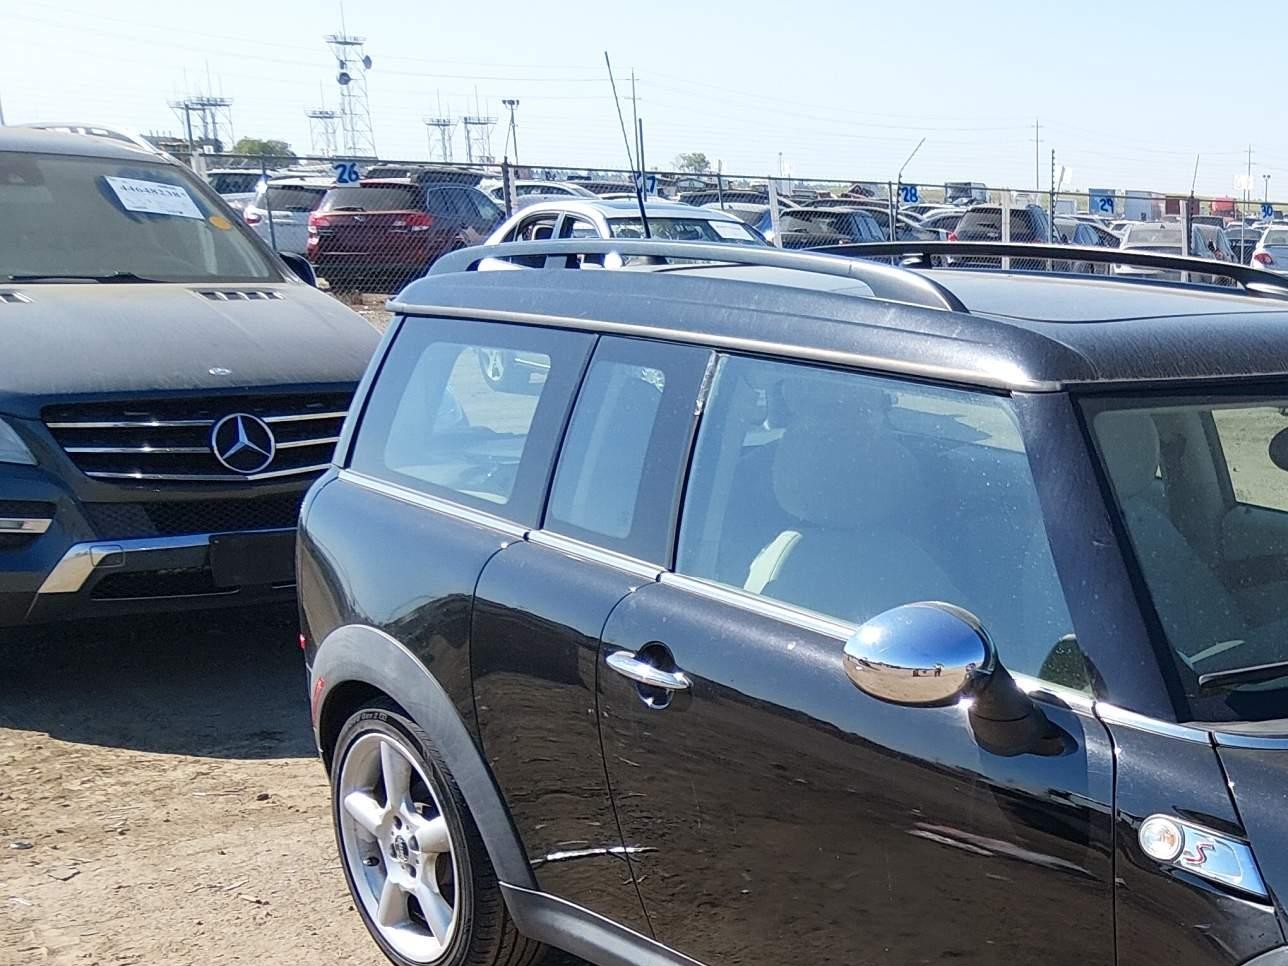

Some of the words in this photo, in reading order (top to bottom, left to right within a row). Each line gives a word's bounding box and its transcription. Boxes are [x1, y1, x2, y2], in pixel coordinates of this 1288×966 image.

[334, 162, 359, 184] 26
[901, 186, 918, 203] 28
[1100, 198, 1114, 215] 29
[1261, 203, 1273, 219] 30
